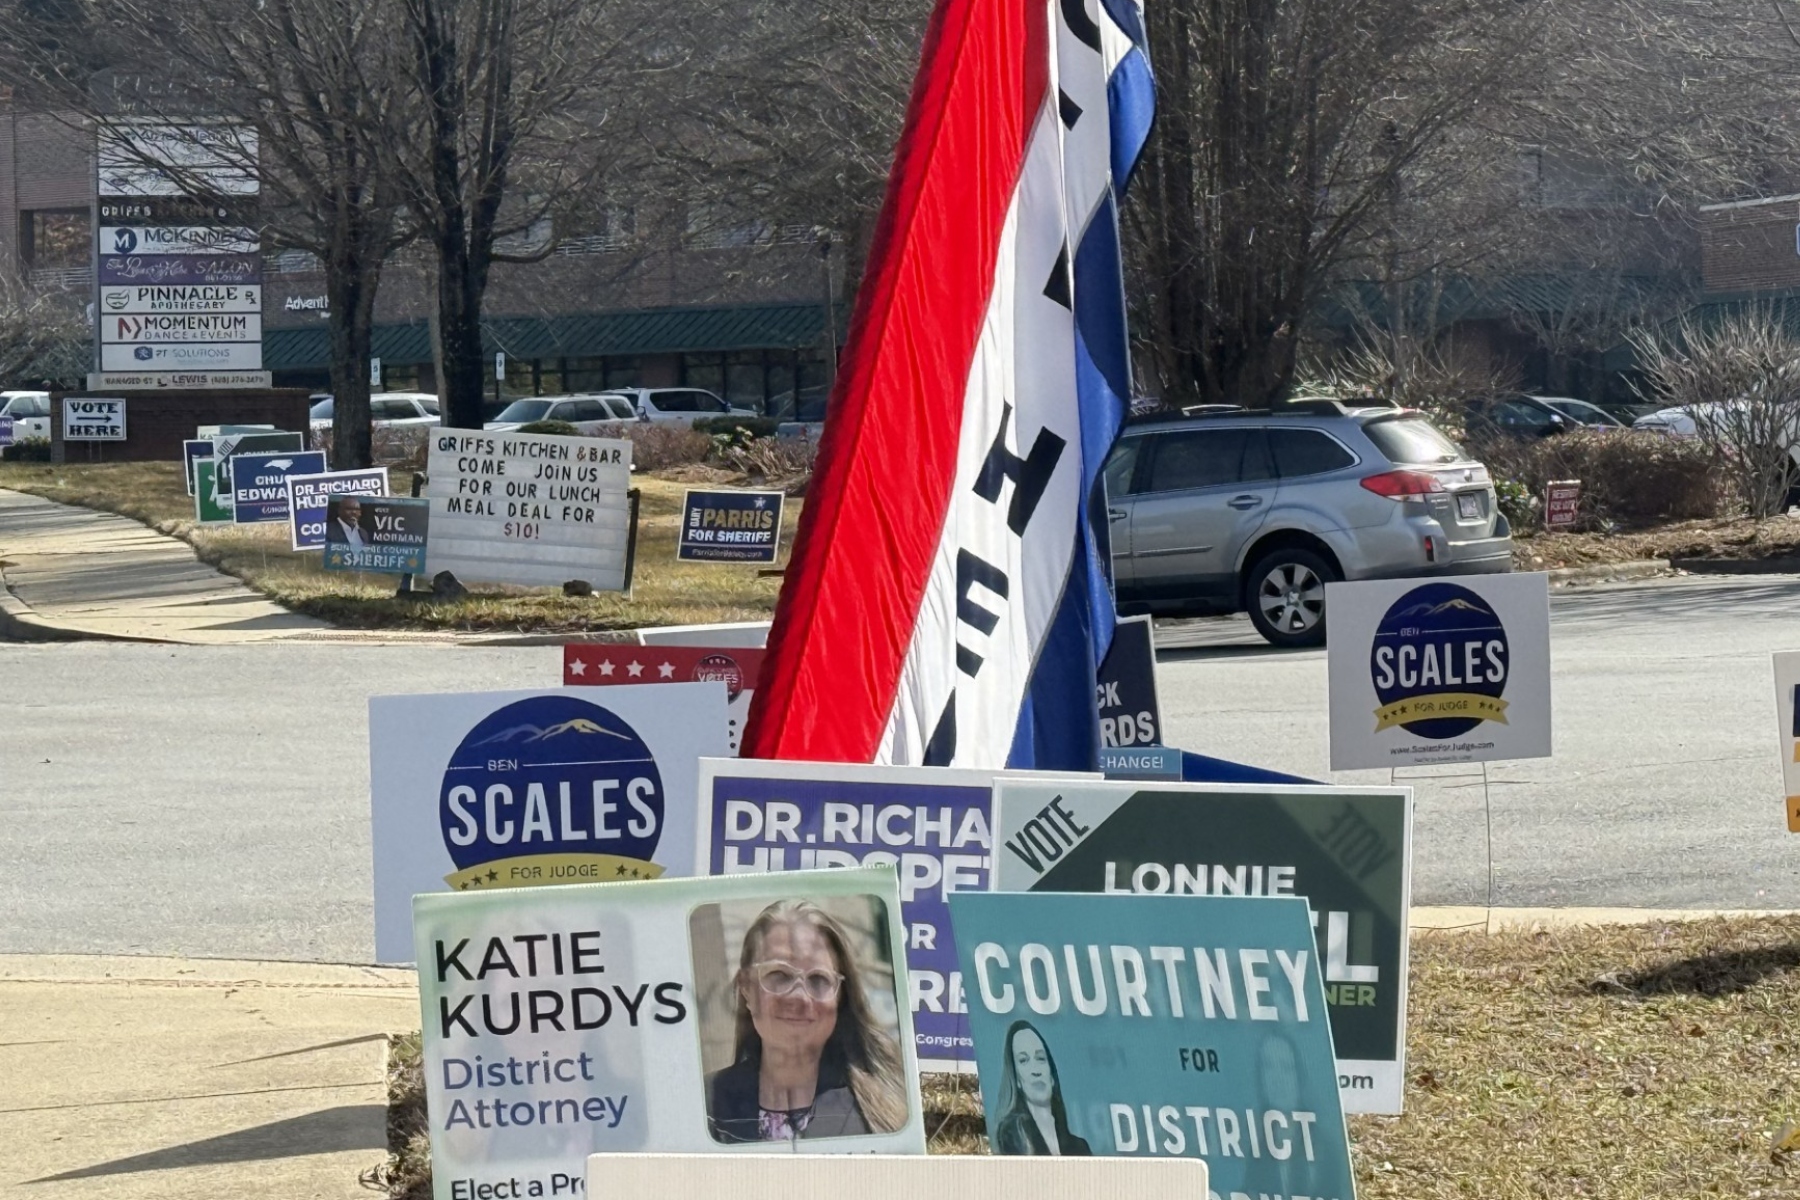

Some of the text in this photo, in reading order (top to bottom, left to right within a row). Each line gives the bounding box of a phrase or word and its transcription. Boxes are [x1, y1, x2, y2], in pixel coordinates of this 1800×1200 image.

[137, 287, 238, 301] PINNACLE
[150, 301, 226, 310] APOTHECARY
[144, 316, 247, 330] MOMENTUM
[144, 331, 188, 340] DANCE
[200, 330, 247, 340] EVENTS
[171, 375, 208, 384] LEWIS
[69, 402, 119, 413] VOTE
[68, 425, 121, 436] HERE
[438, 437, 494, 455] GRIFFS
[503, 440, 569, 460] KITCHEN
[458, 457, 505, 475] COME
[577, 467, 598, 482] US
[459, 478, 600, 503] FOR OUR LUNCH
[447, 498, 595, 523] MEAL DEAL FOR
[703, 508, 774, 529] PARRIS
[374, 516, 405, 531] VIC
[504, 522, 539, 539] $10!
[373, 532, 423, 543] MORMAN
[688, 529, 772, 543] FOR SHERIFF
[343, 553, 405, 568] SHERIFF
[1400, 627, 1420, 637] BEN
[1376, 640, 1505, 689] SCALES
[1414, 701, 1469, 712] FOR JUDGE
[487, 759, 519, 771] BEN
[447, 776, 657, 846] SCALES
[1004, 793, 1090, 876] VOTE
[510, 864, 599, 879] FOR JUDGE
[1104, 861, 1296, 897] LONNIE
[435, 931, 605, 983] KATIE
[974, 941, 1309, 1022] COURTNEY
[439, 981, 688, 1039] KURDYS
[443, 1051, 595, 1090] District
[1179, 1047, 1221, 1073] FOR
[444, 1095, 629, 1132] Attorney
[1110, 1102, 1317, 1162] DISTRICT
[451, 1177, 521, 1200] Elect
[527, 1180, 545, 1197] a
